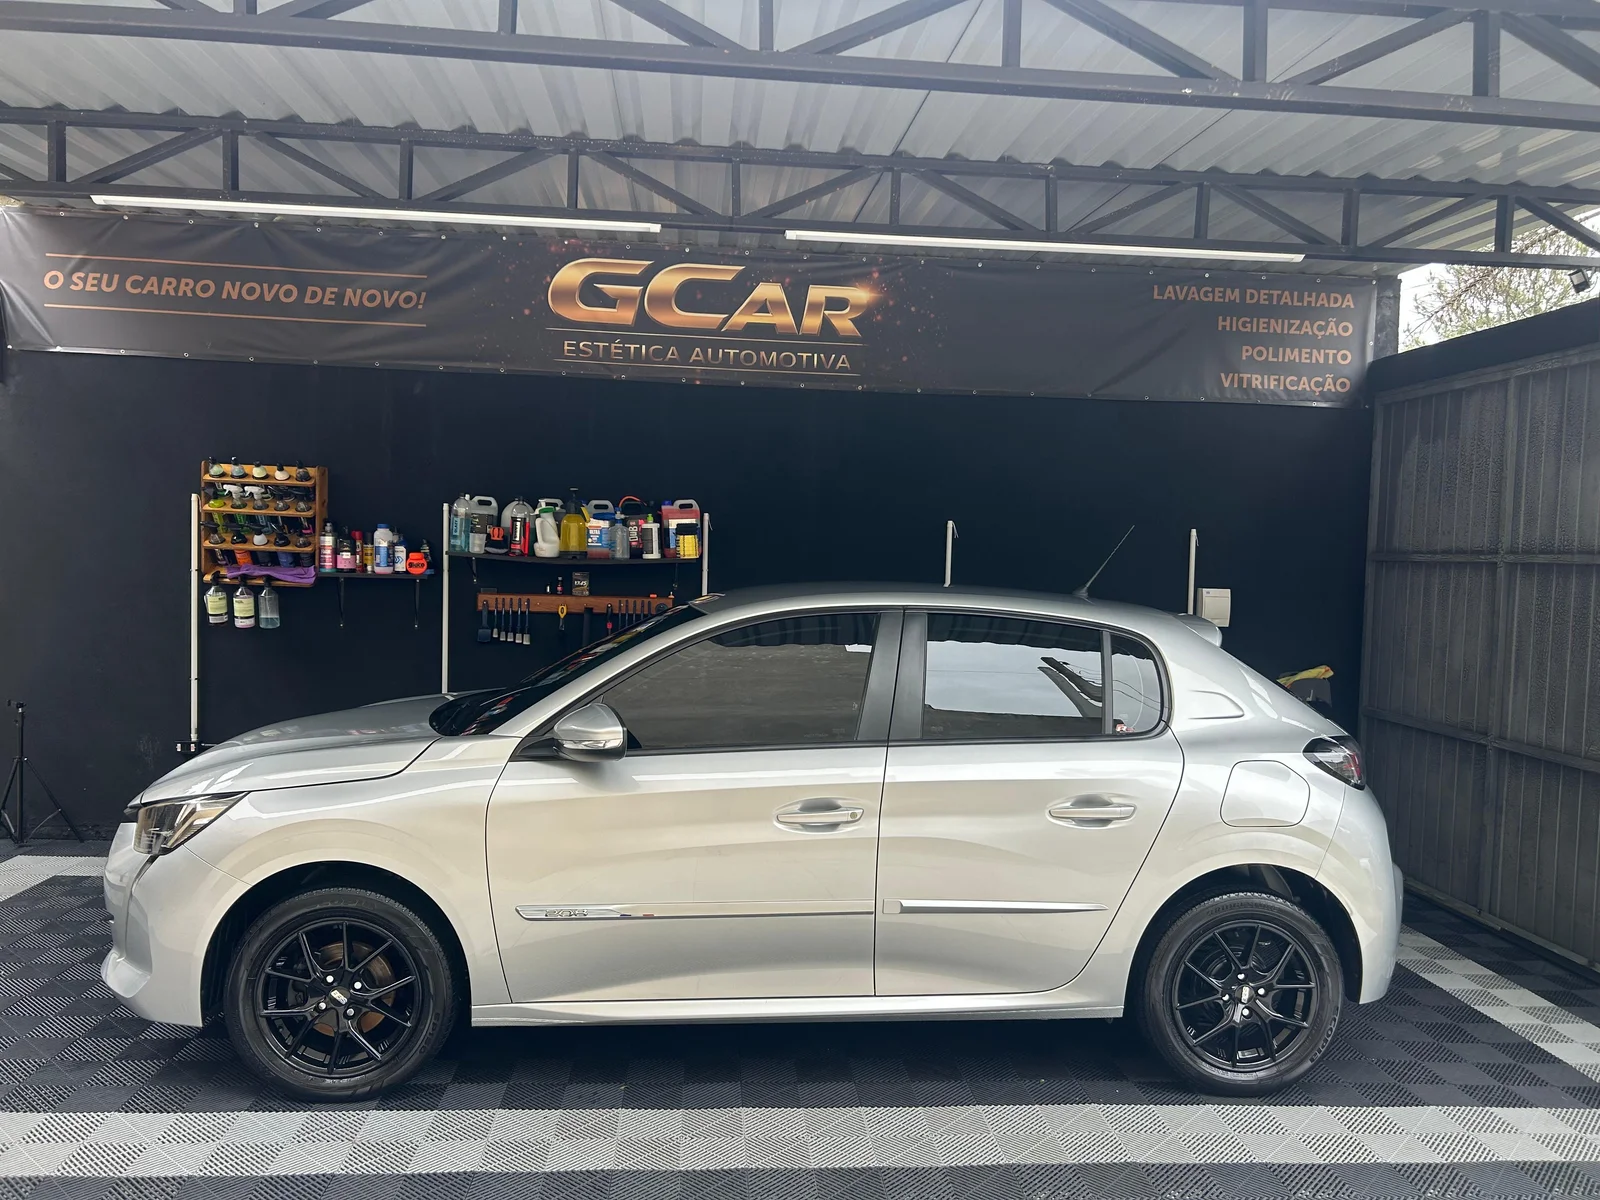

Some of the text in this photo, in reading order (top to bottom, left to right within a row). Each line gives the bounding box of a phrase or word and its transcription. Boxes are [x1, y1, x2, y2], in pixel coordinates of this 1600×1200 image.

[43, 270, 427, 310] O SEU CARRO NOVO DE NOVO!
[547, 257, 871, 338] GCAR
[1152, 284, 1355, 309] LAVAGEM DETALHADA
[1217, 315, 1354, 340] HIGIENIZAÇÃO
[563, 338, 851, 371] ESTÉTICA AUTOMOTIVA
[1240, 345, 1352, 366] POLIMENTO
[1220, 372, 1351, 396] VITRIFICAÇÃO
